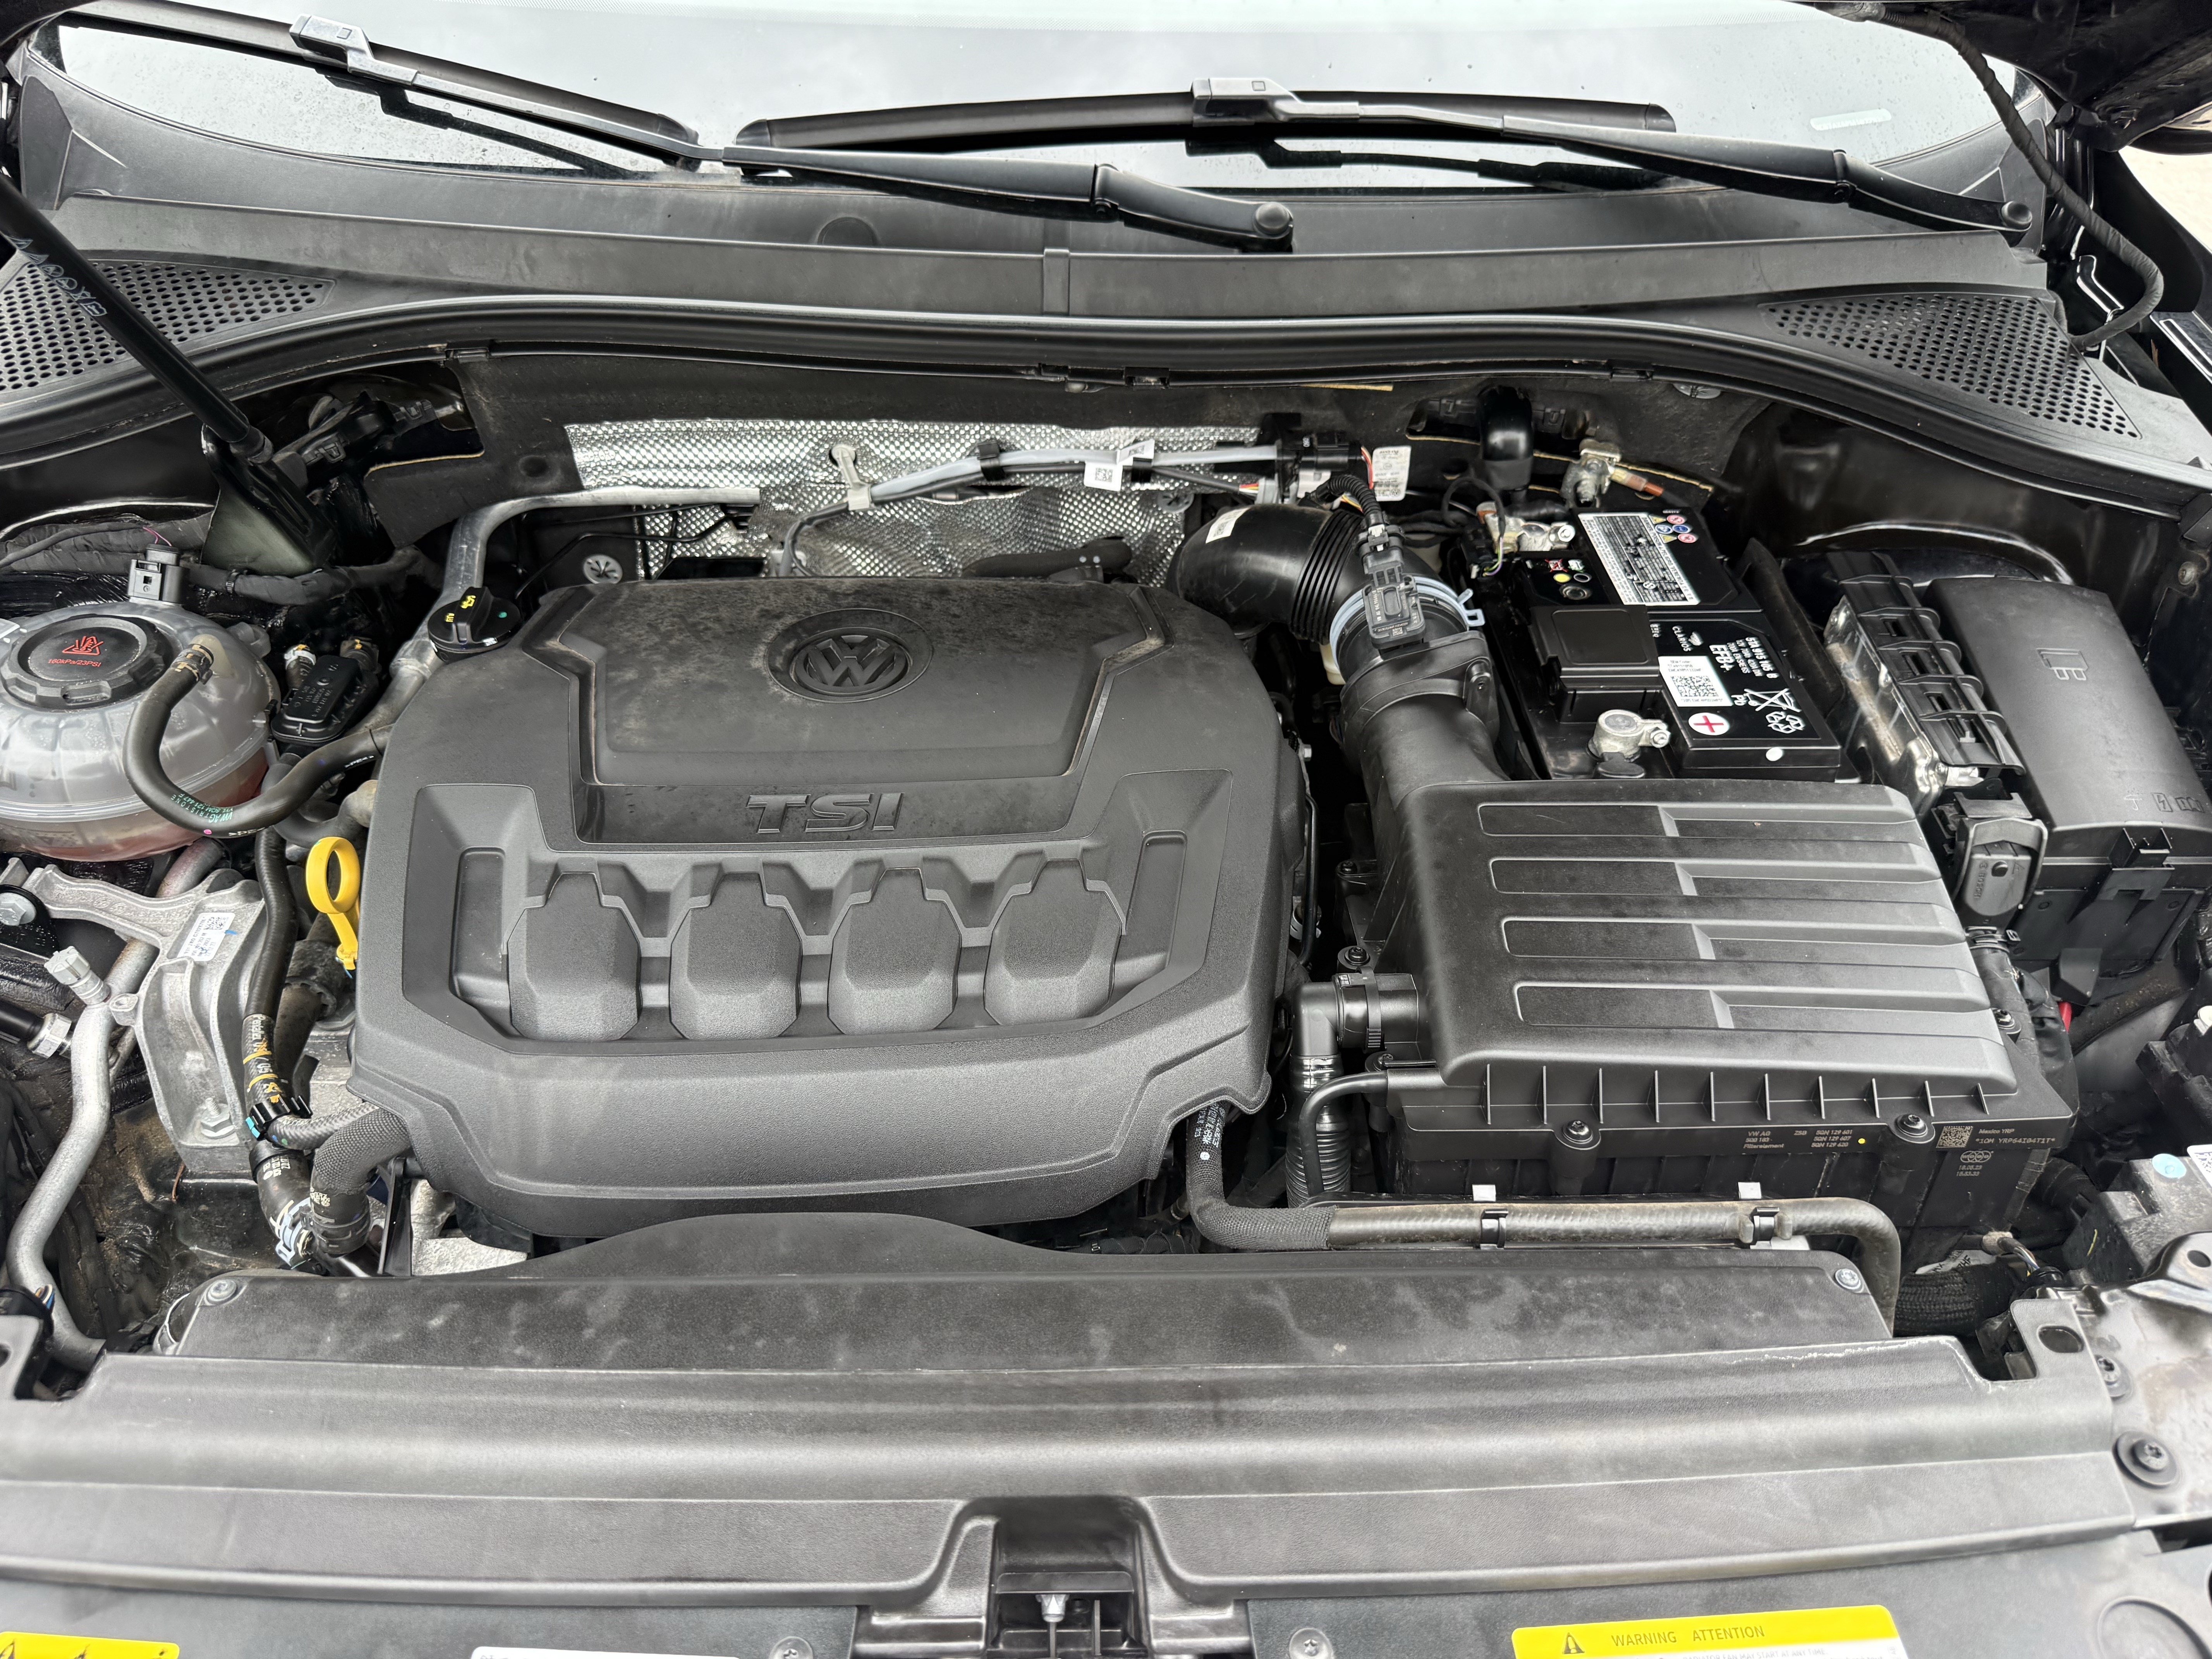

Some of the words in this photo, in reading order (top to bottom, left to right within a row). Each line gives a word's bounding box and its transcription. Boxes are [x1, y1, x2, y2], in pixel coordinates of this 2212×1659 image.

[1673, 625, 1692, 651] CLARIOS
[1709, 645, 1735, 671] EFB+
[1752, 648, 1768, 659] 915
[1759, 660, 1774, 671] 105
[1731, 695, 1748, 706] Pb
[171, 795, 210, 818] TRISTONE
[746, 793, 905, 833] TSI
[1611, 1631, 1676, 1647] WARNING
[1693, 1626, 1765, 1642] ATTENTION
[1757, 1650, 1778, 1659] START
